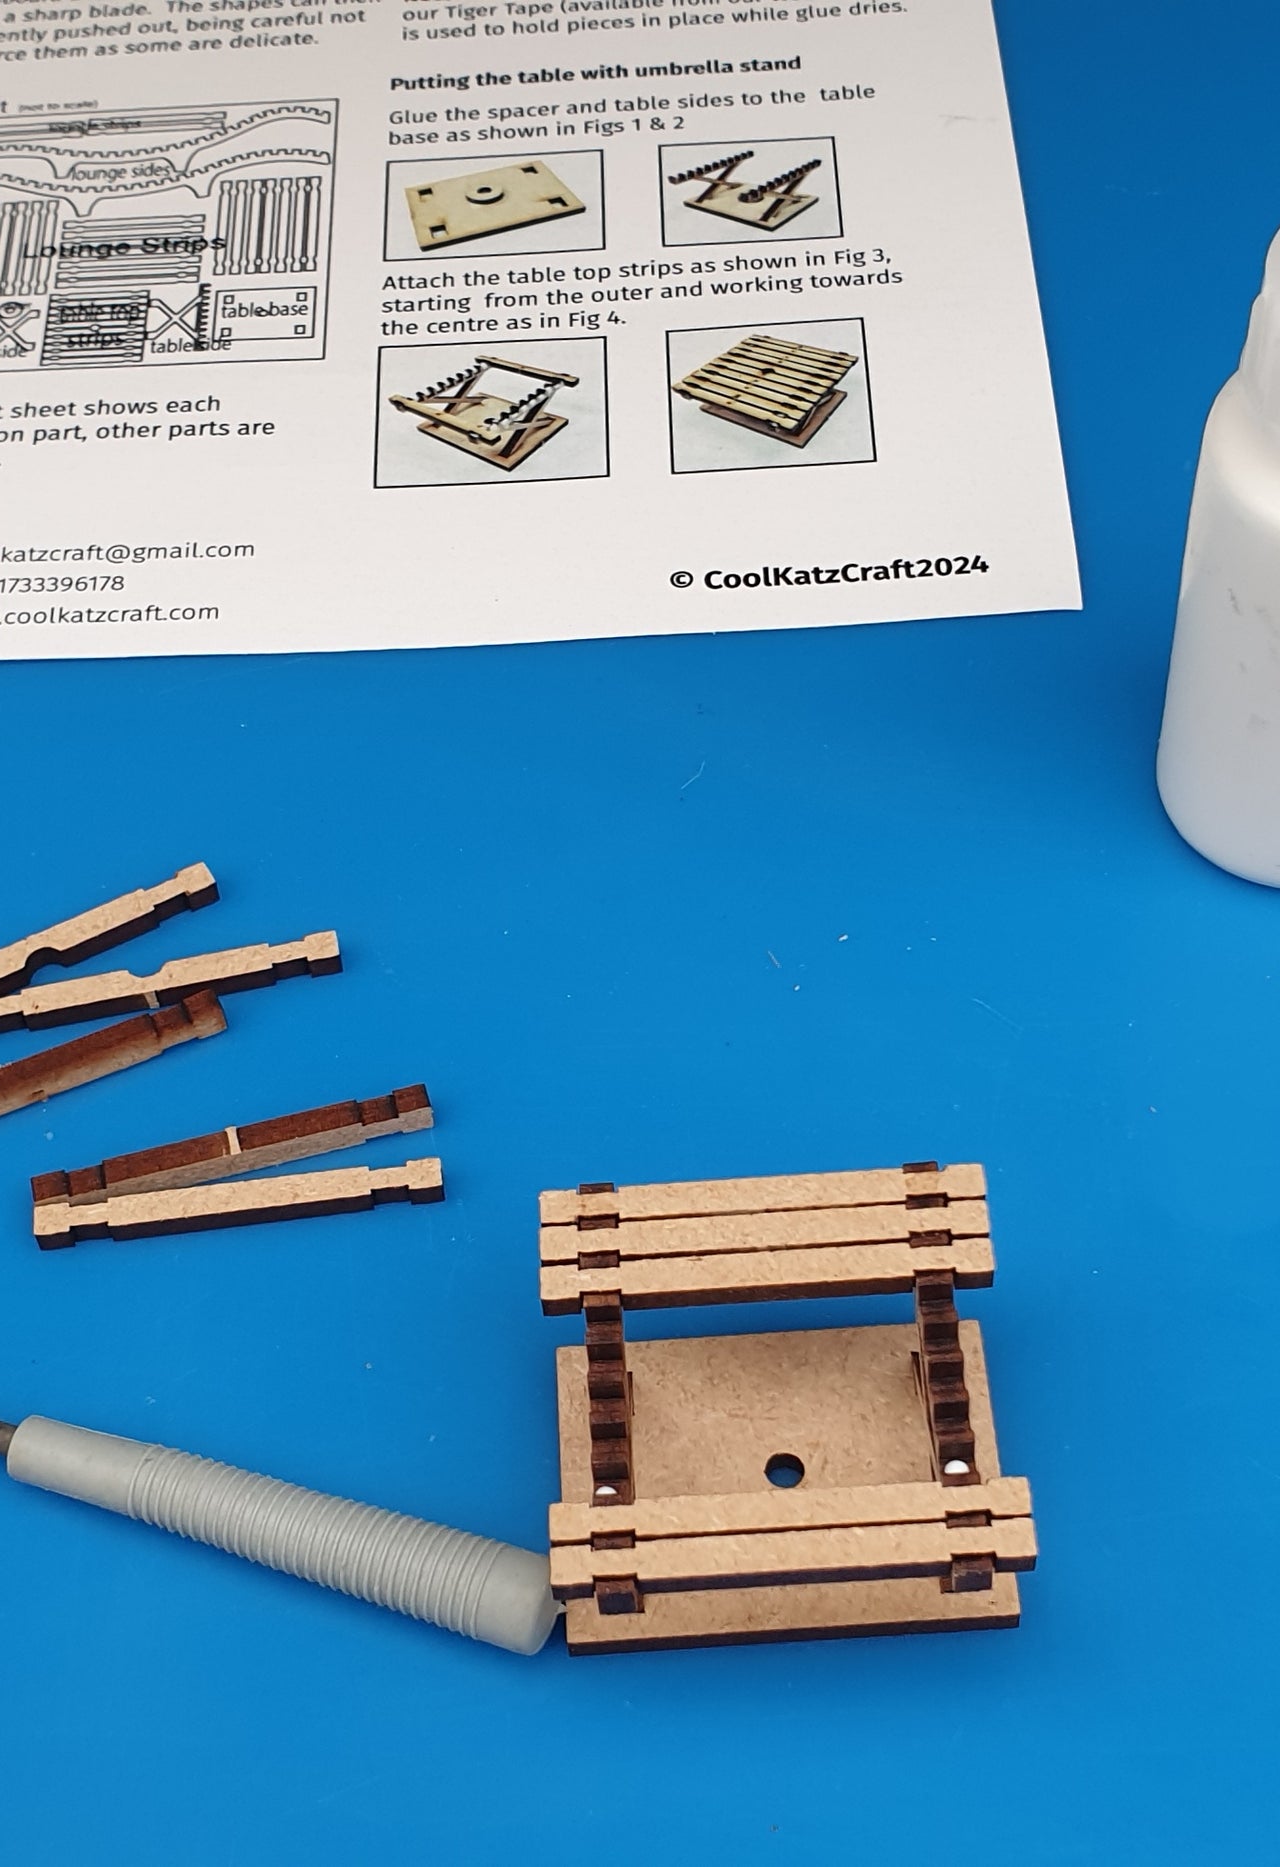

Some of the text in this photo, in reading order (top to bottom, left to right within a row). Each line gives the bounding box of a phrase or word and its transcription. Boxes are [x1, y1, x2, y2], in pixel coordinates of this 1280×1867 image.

[3, 14, 16, 23] a
[23, 7, 82, 23] sharp
[89, 3, 152, 19] blade.
[166, 0, 203, 13] The
[209, 0, 284, 12] shapes
[402, 8, 439, 22] our
[447, 4, 498, 20] Tiger
[506, 1, 554, 17] Tape
[402, 0, 908, 41] is used to hold pieces in place while glue dries.
[53, 22, 132, 42] pushed
[137, 20, 179, 35] out,
[186, 16, 245, 32] being
[250, 11, 323, 29] careful
[330, 10, 366, 24] not
[34, 45, 88, 60] them
[94, 43, 119, 57] as
[124, 39, 182, 54] some
[188, 38, 223, 51] are
[229, 31, 319, 49] delicate.
[390, 55, 802, 90] Putting the table with umbrella stand
[389, 84, 876, 125] Glue the spacer and table sides to the table
[388, 116, 685, 146] base as shown in Figs 1 & 2
[72, 162, 170, 182] lounge sides
[24, 236, 228, 259] Lounge Strips
[382, 248, 892, 290] Attach the table top strips as shown in Fig 3,
[381, 268, 904, 314] starting from the outer and working towards
[269, 301, 309, 317] base
[381, 310, 626, 336] the centre as in Fig 4.
[150, 338, 232, 353] table ide
[10, 400, 77, 420] sheet
[83, 397, 158, 417] shows
[165, 395, 221, 414] each
[32, 424, 88, 446] part,
[95, 420, 163, 440] other
[168, 418, 231, 440] parts
[237, 420, 276, 437] are
[704, 555, 989, 590] CoolKatzCraft2024
